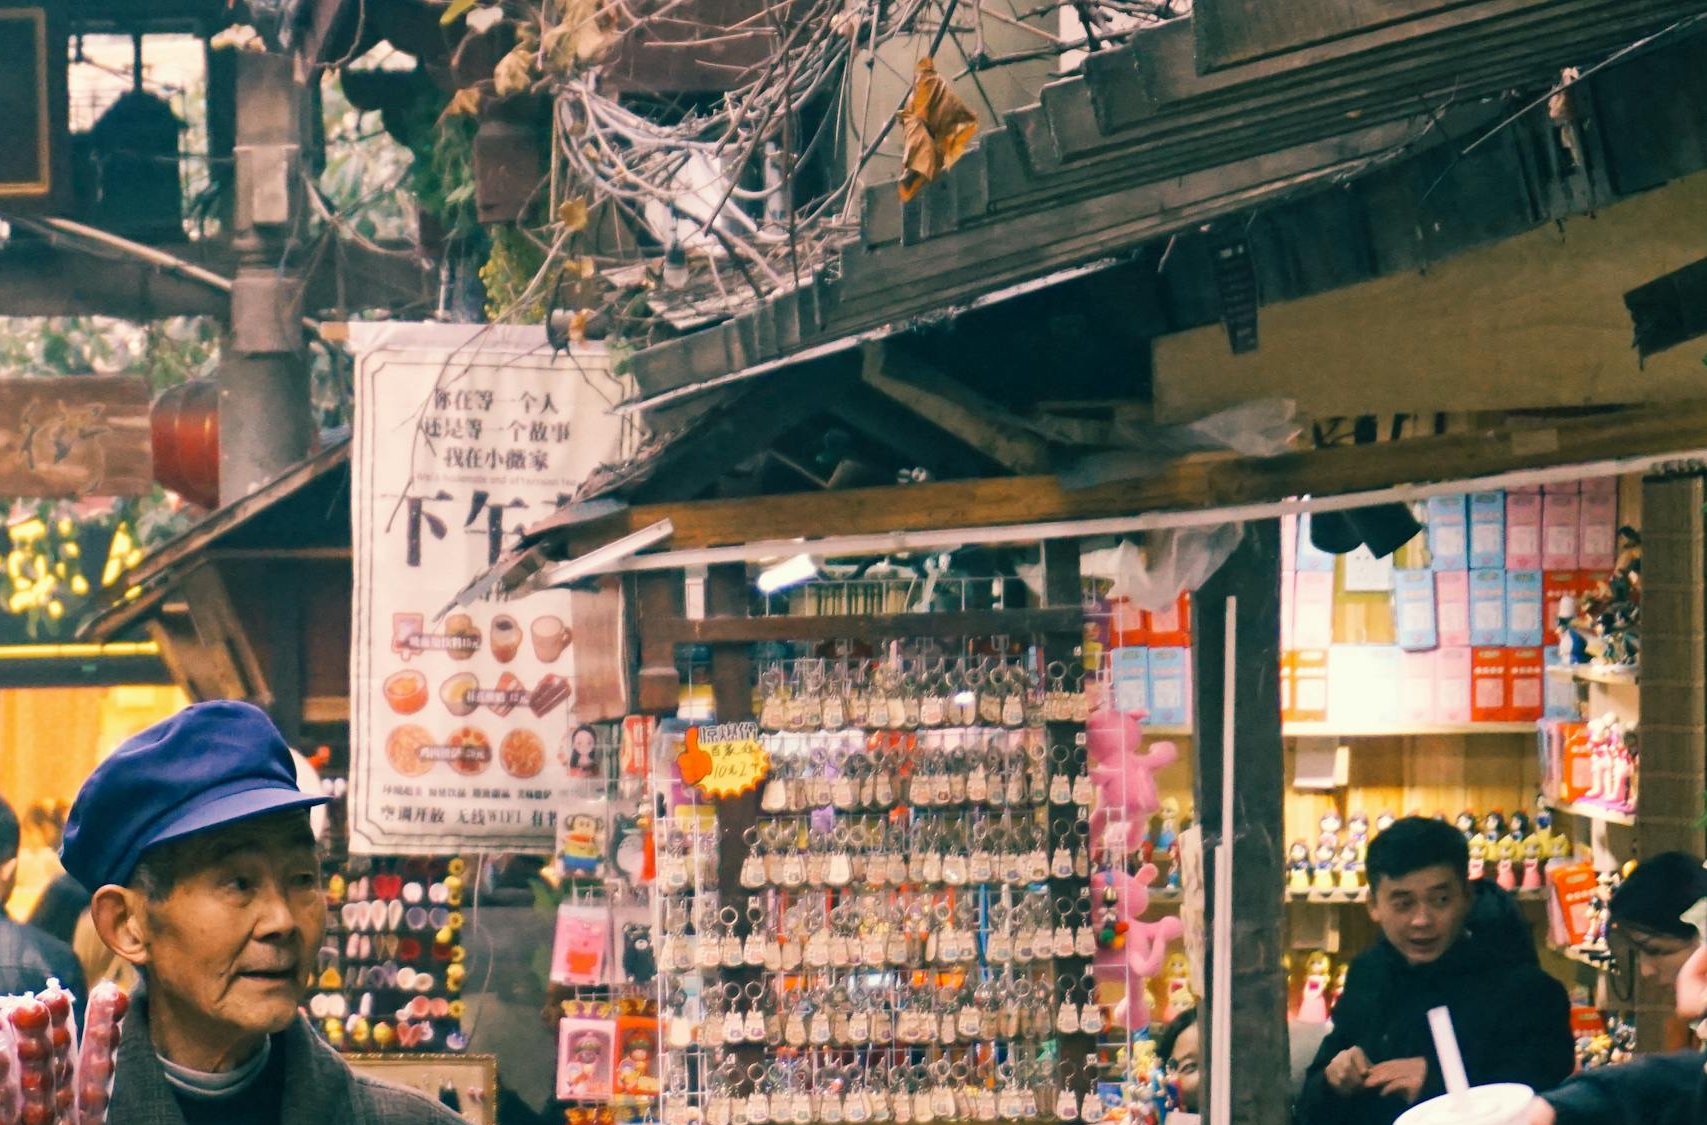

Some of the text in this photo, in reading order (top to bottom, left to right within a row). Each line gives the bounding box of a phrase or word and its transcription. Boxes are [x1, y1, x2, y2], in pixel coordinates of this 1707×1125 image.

[434, 388, 559, 415] 你在等一个人
[424, 416, 571, 443] 还是等一个故事
[381, 489, 573, 568] 下午
[698, 721, 758, 745] 惊爆价
[381, 805, 445, 824] 空调开放
